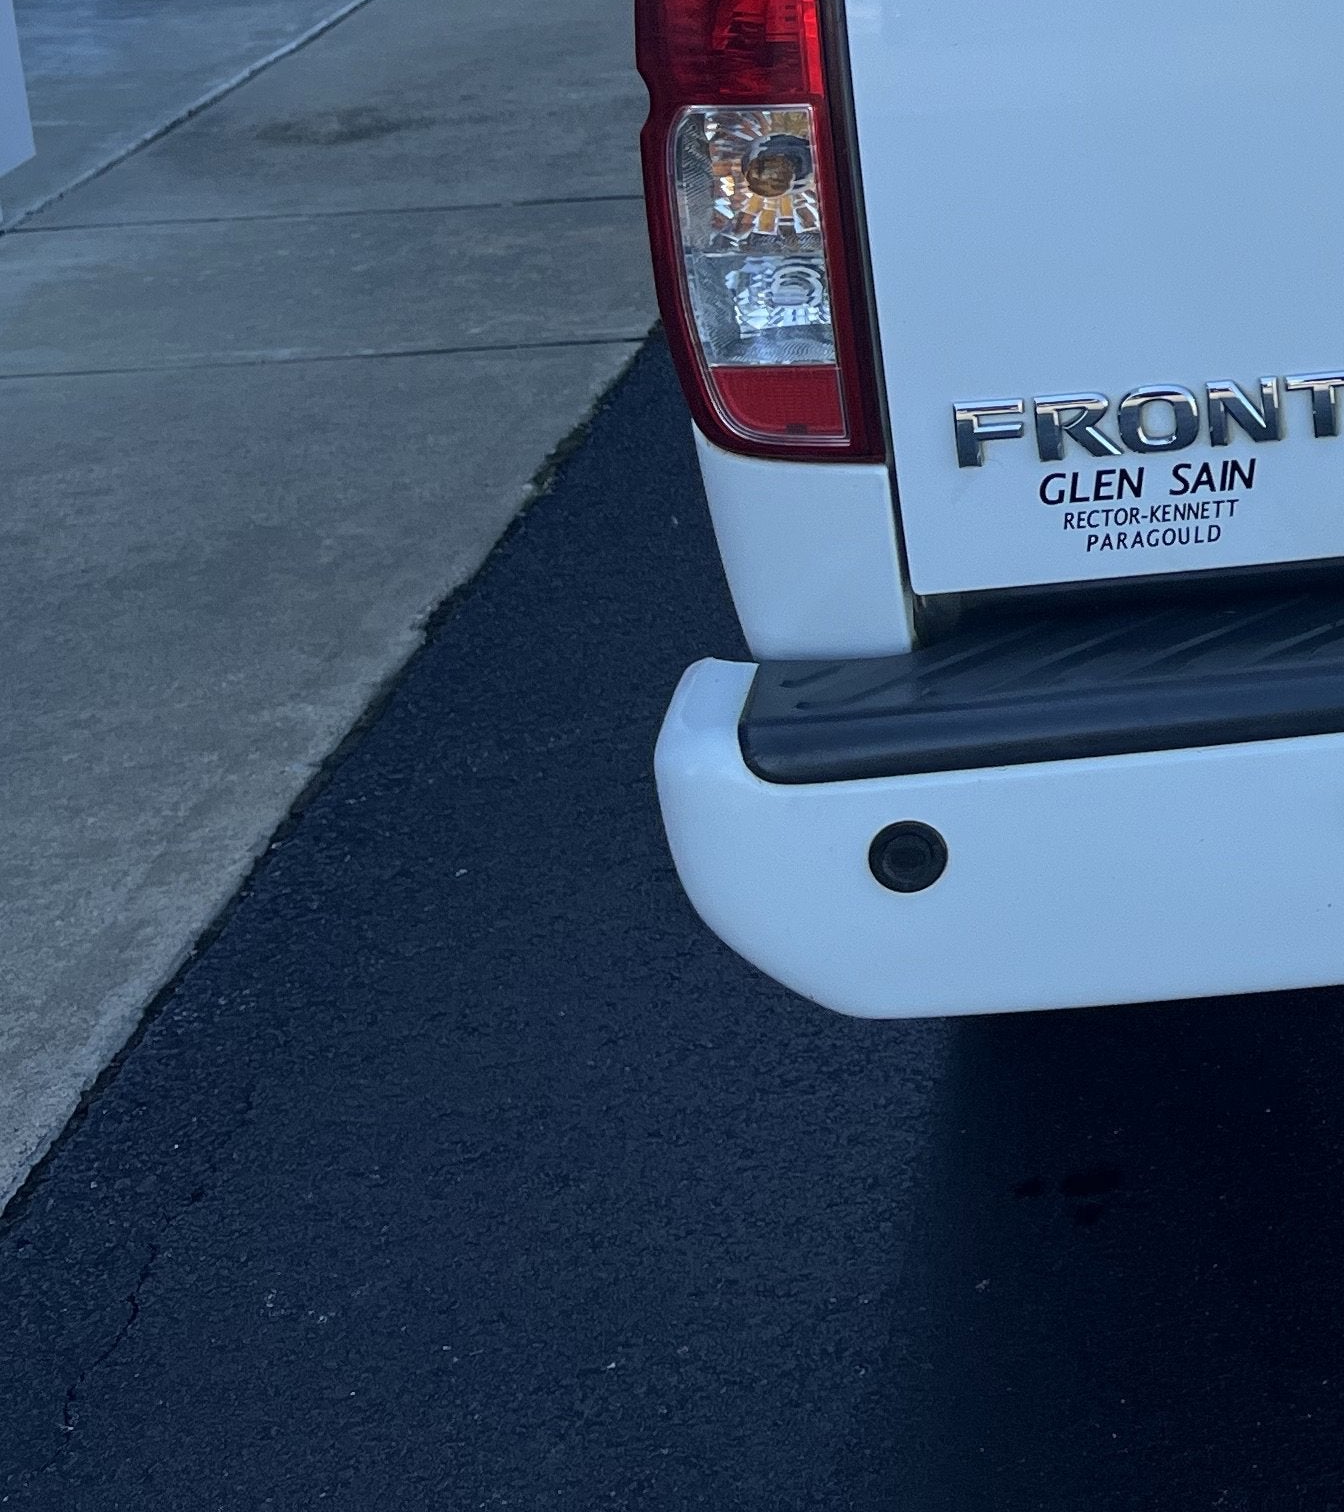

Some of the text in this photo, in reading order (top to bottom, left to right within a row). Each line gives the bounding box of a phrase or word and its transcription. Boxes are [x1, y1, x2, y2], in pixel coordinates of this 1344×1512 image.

[1039, 458, 1256, 505] GLEN SAIN
[1063, 499, 1240, 530] RECTOR-KENNETT
[1086, 524, 1222, 553] PARAGOULD
